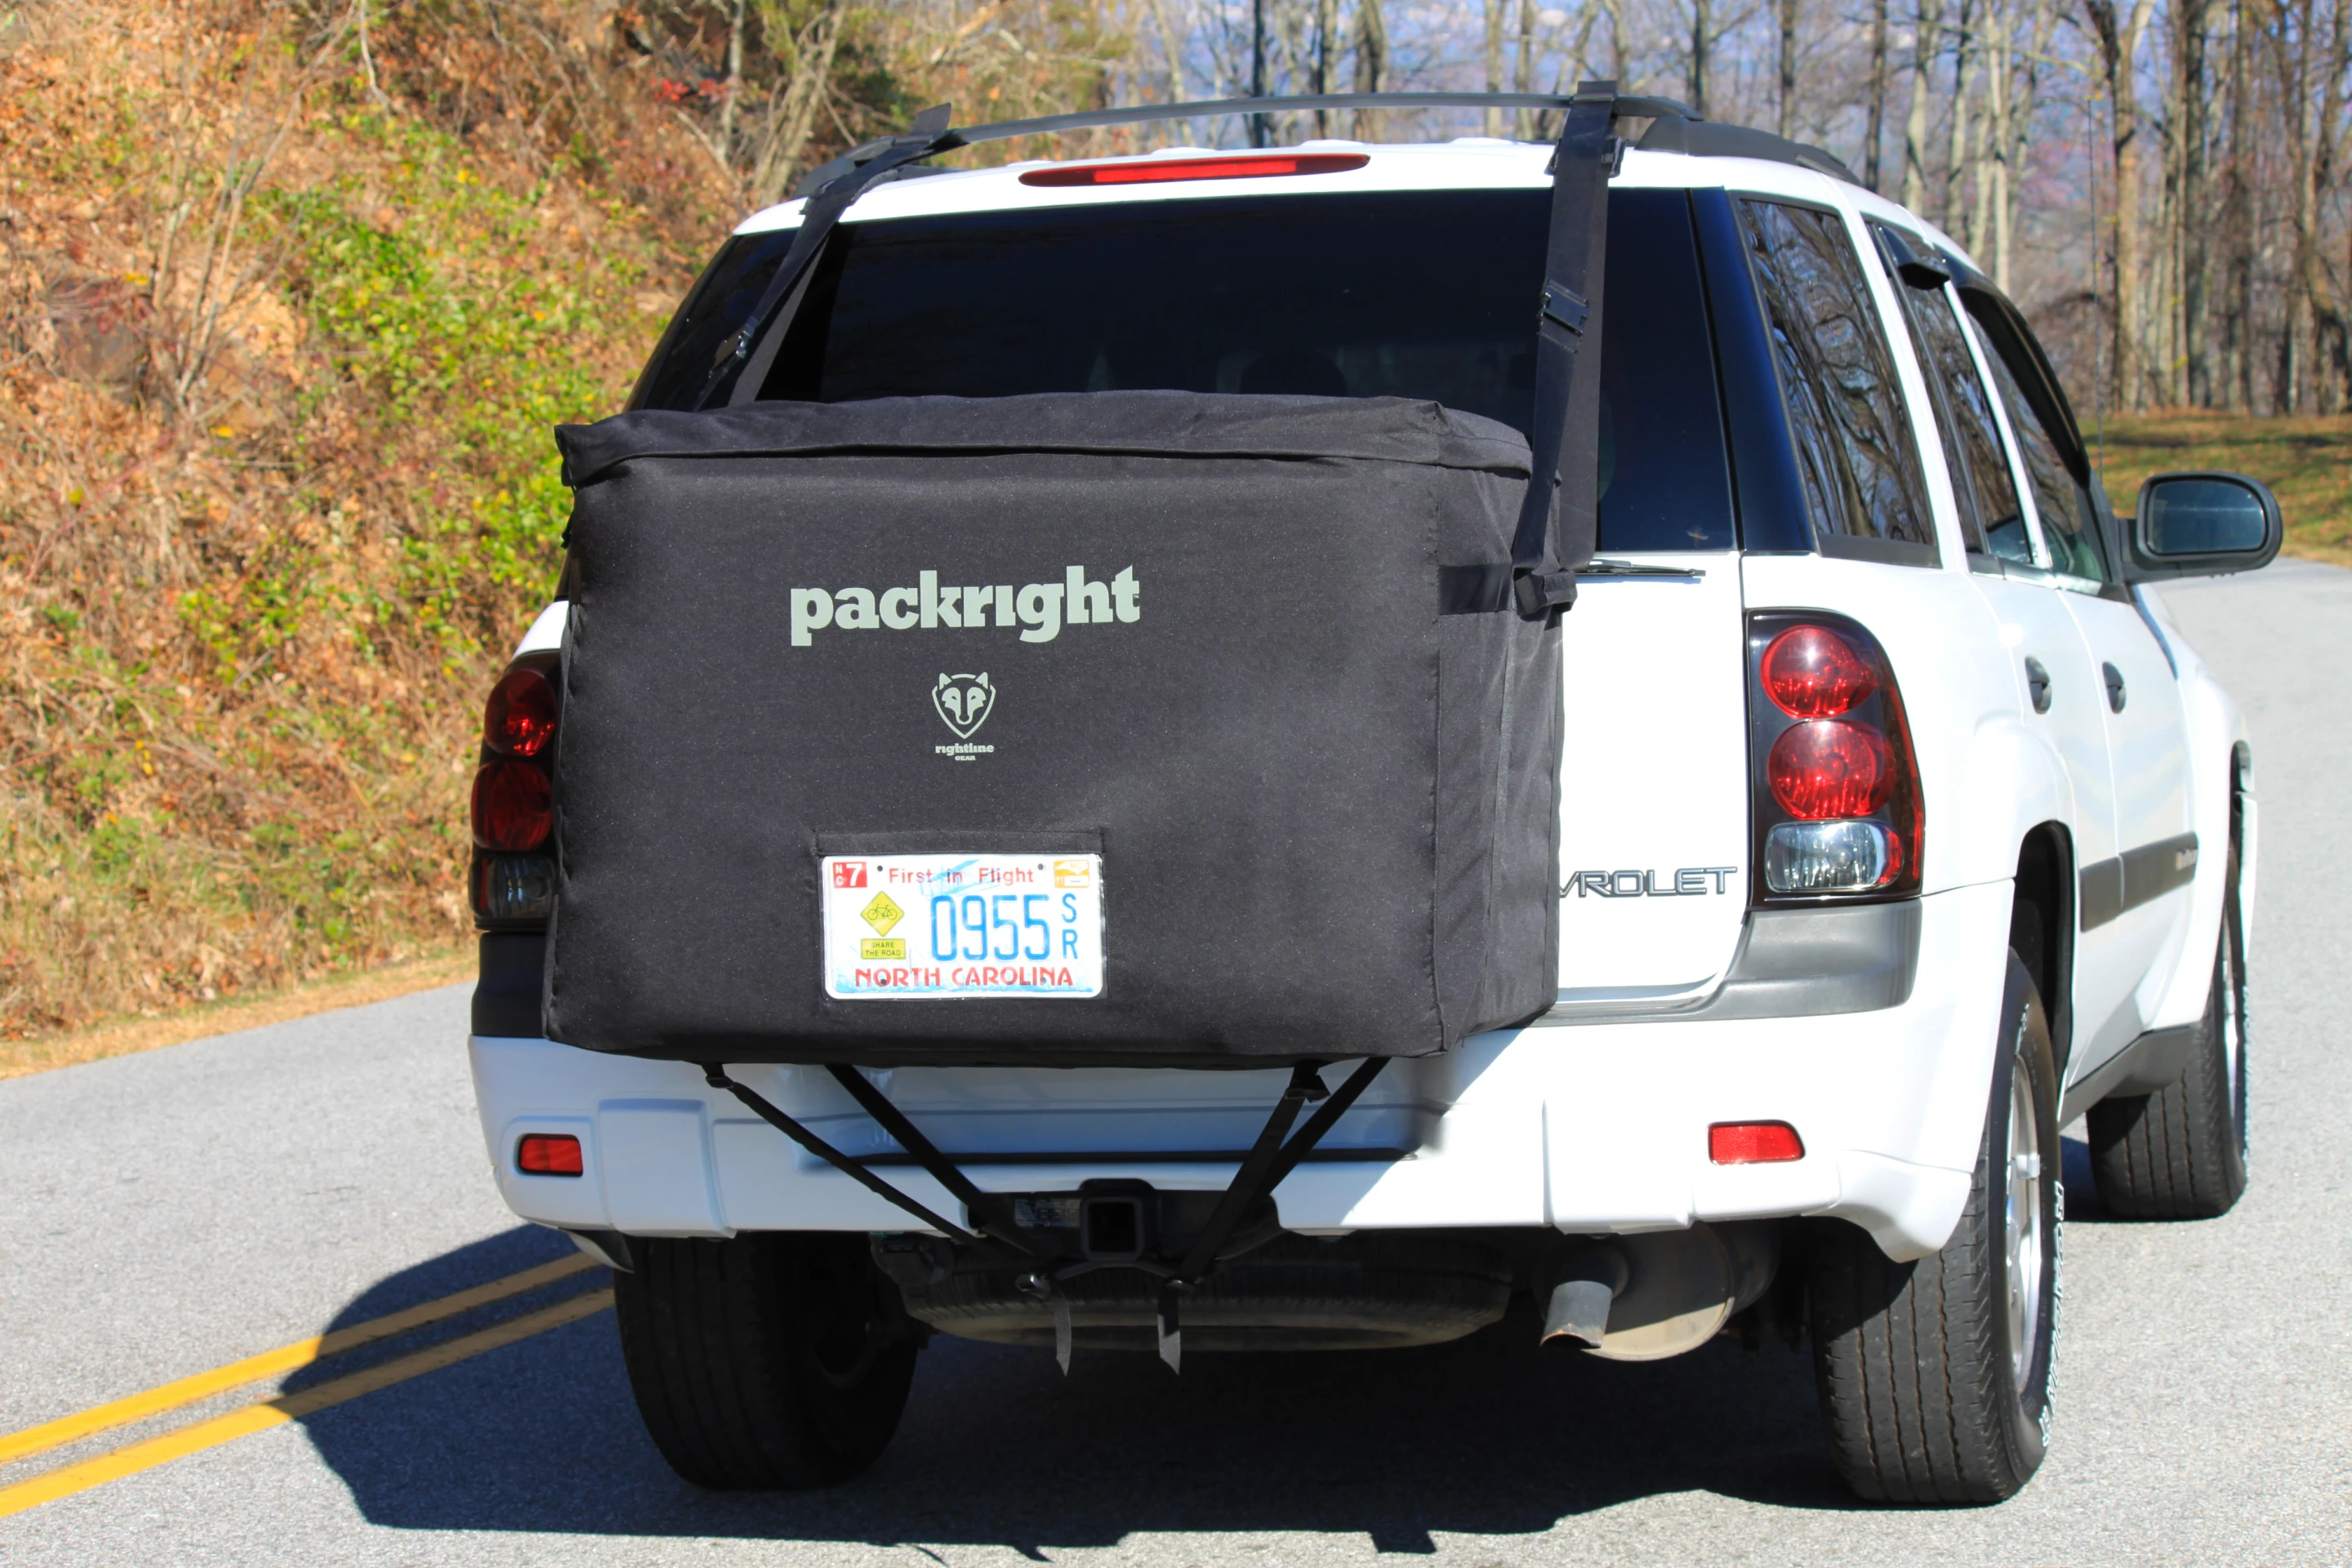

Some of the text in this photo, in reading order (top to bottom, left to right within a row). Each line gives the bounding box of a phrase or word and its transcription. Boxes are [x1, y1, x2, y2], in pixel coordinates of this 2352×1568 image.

[791, 564, 1141, 647] packright
[935, 742, 995, 756] rightline
[846, 862, 863, 887] 7
[889, 866, 1035, 887] First in Flight
[930, 893, 1051, 962] 0955
[855, 966, 1074, 987] NORTH CAROLINA
